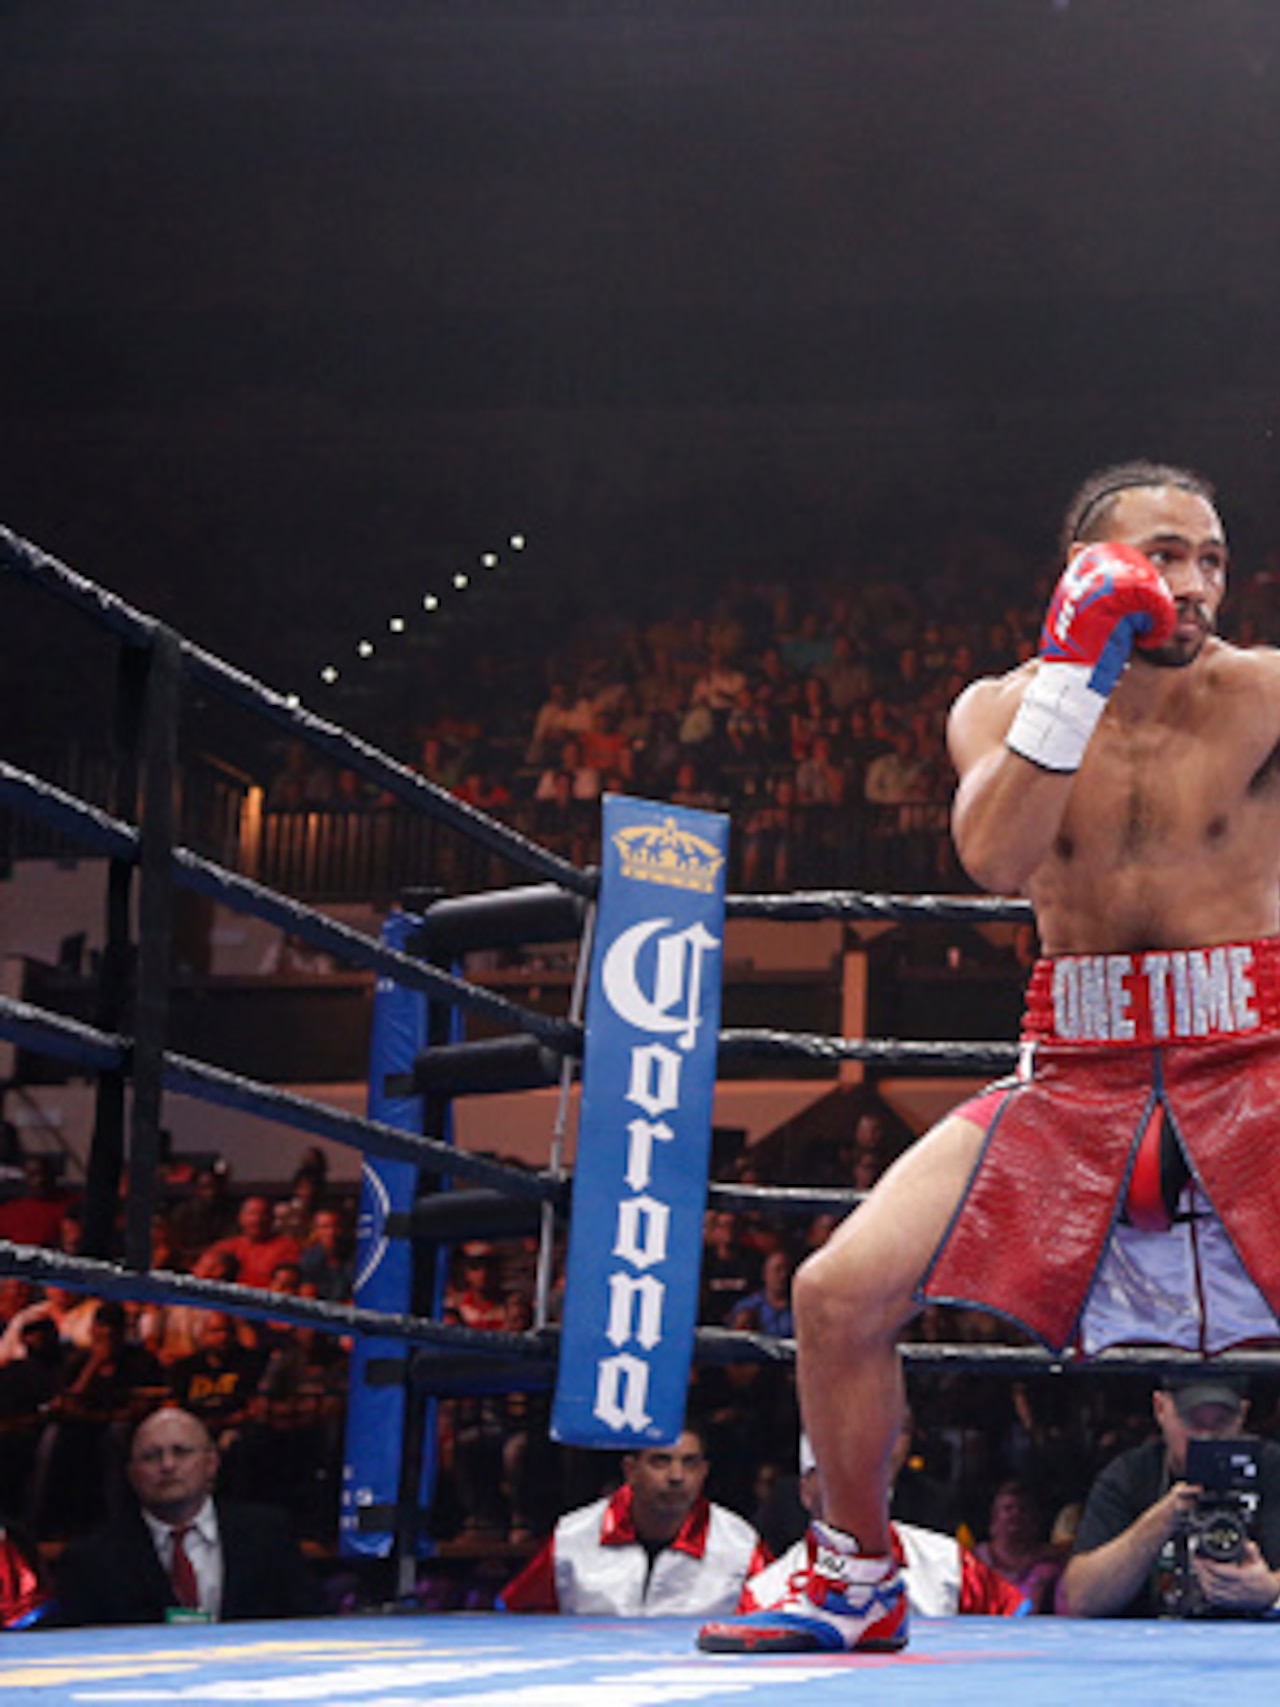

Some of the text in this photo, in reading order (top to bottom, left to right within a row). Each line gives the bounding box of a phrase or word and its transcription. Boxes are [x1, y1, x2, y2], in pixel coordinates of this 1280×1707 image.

[1053, 946, 1258, 1040] ONE TIME
[600, 917, 720, 1433] Corona
